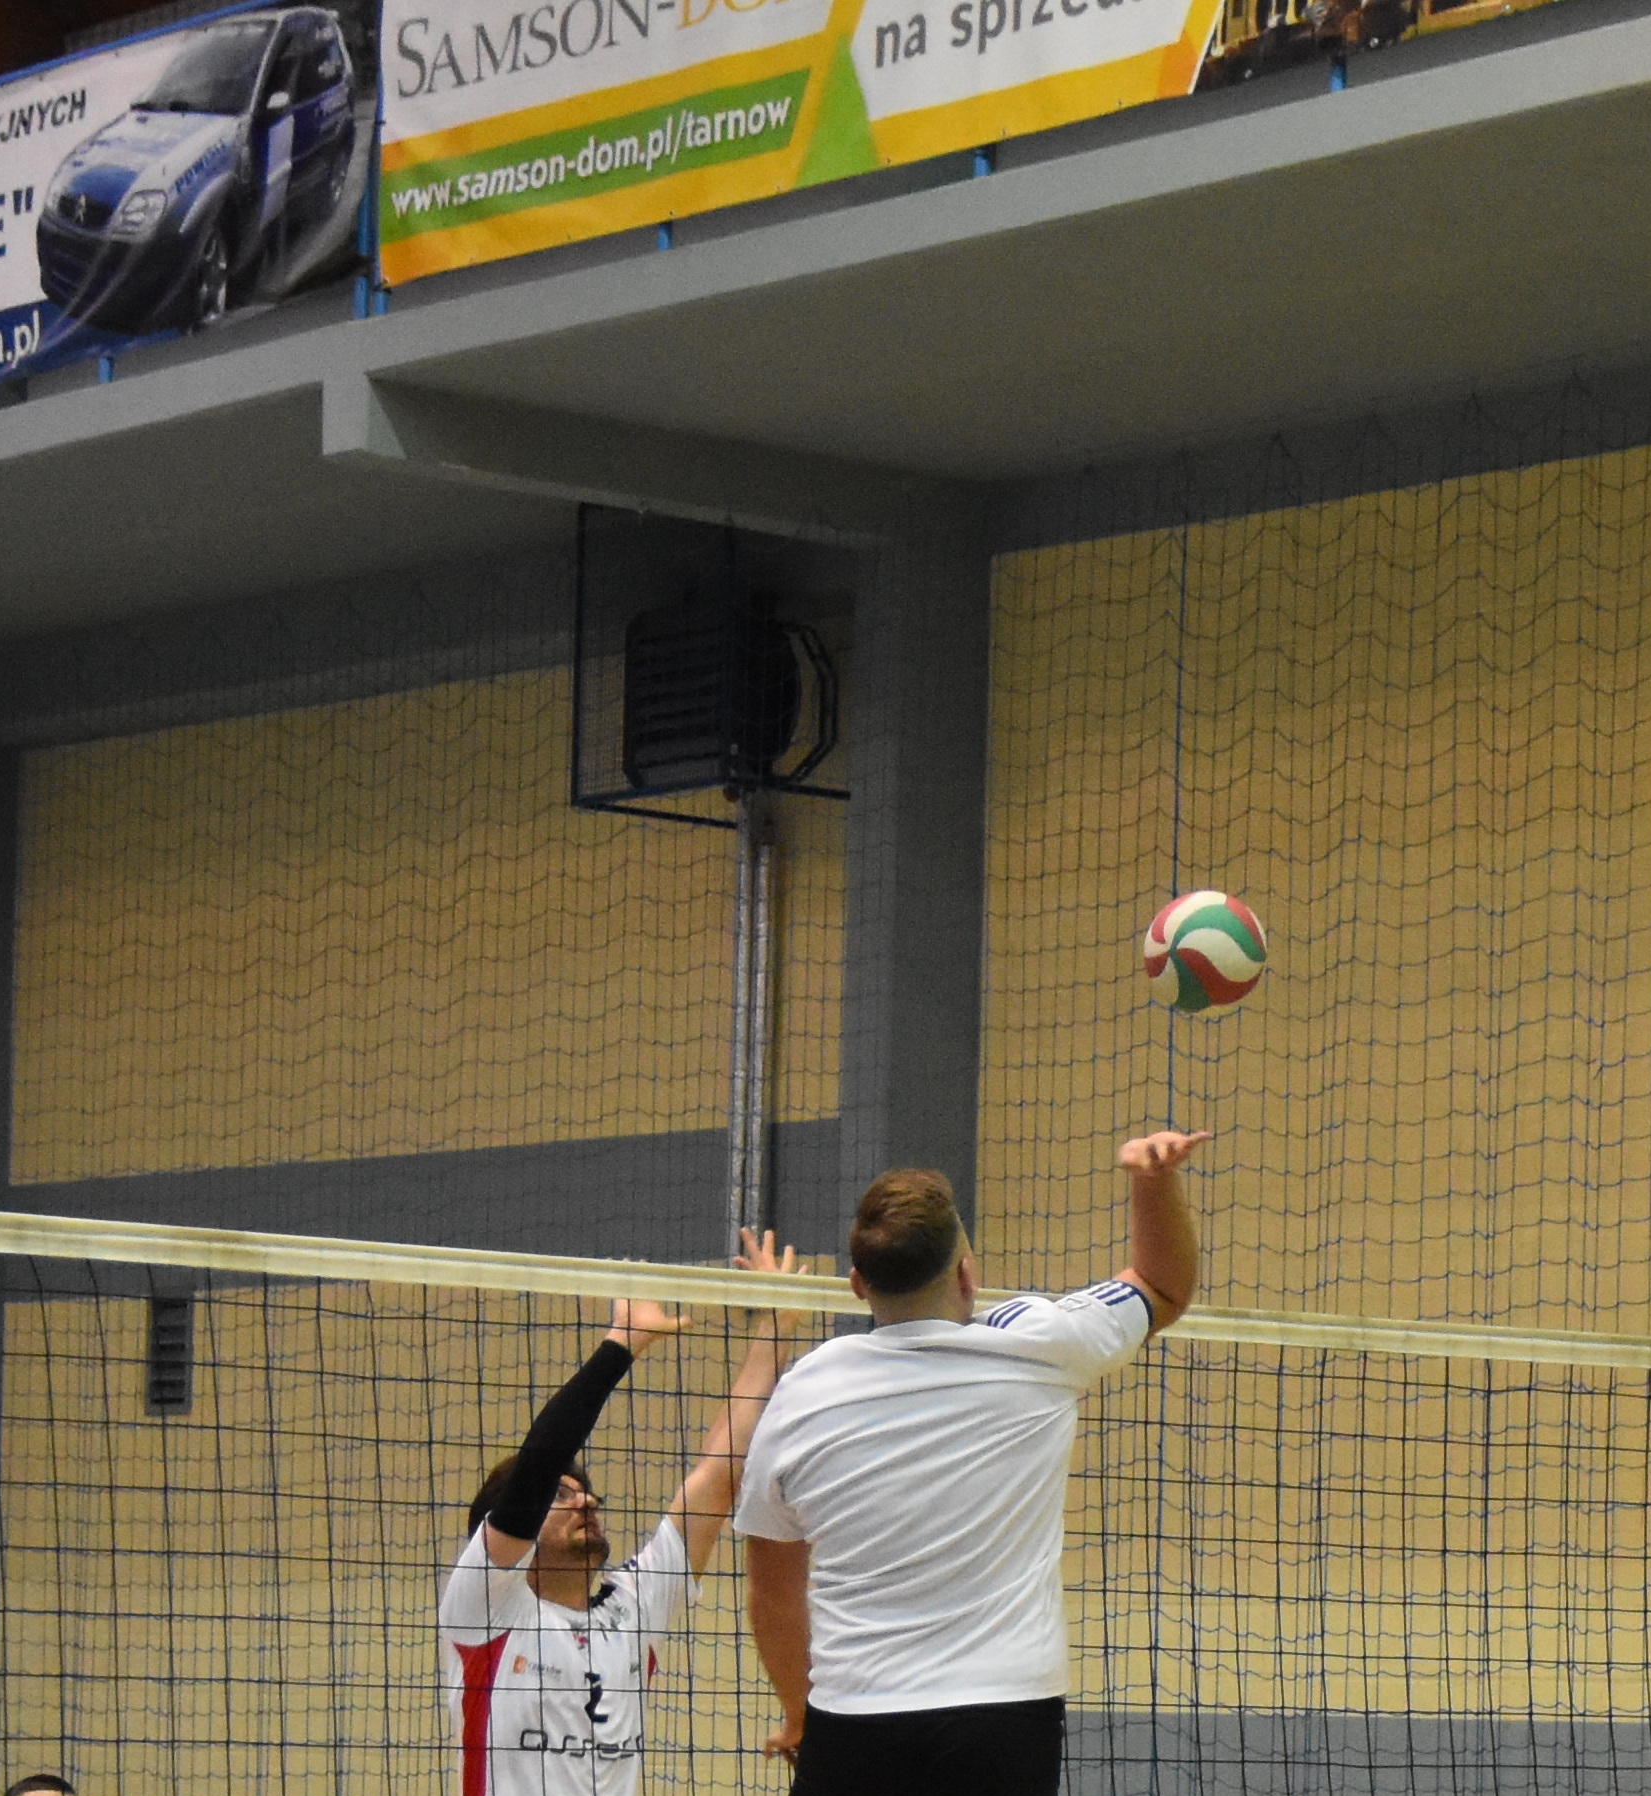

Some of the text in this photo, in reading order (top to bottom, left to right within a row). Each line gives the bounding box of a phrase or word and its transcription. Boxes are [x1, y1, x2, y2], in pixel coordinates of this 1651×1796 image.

[397, 0, 790, 98] SAMSON-
[875, 13, 927, 69] na
[391, 96, 792, 219] www.samson-dom.pl/tarnow
